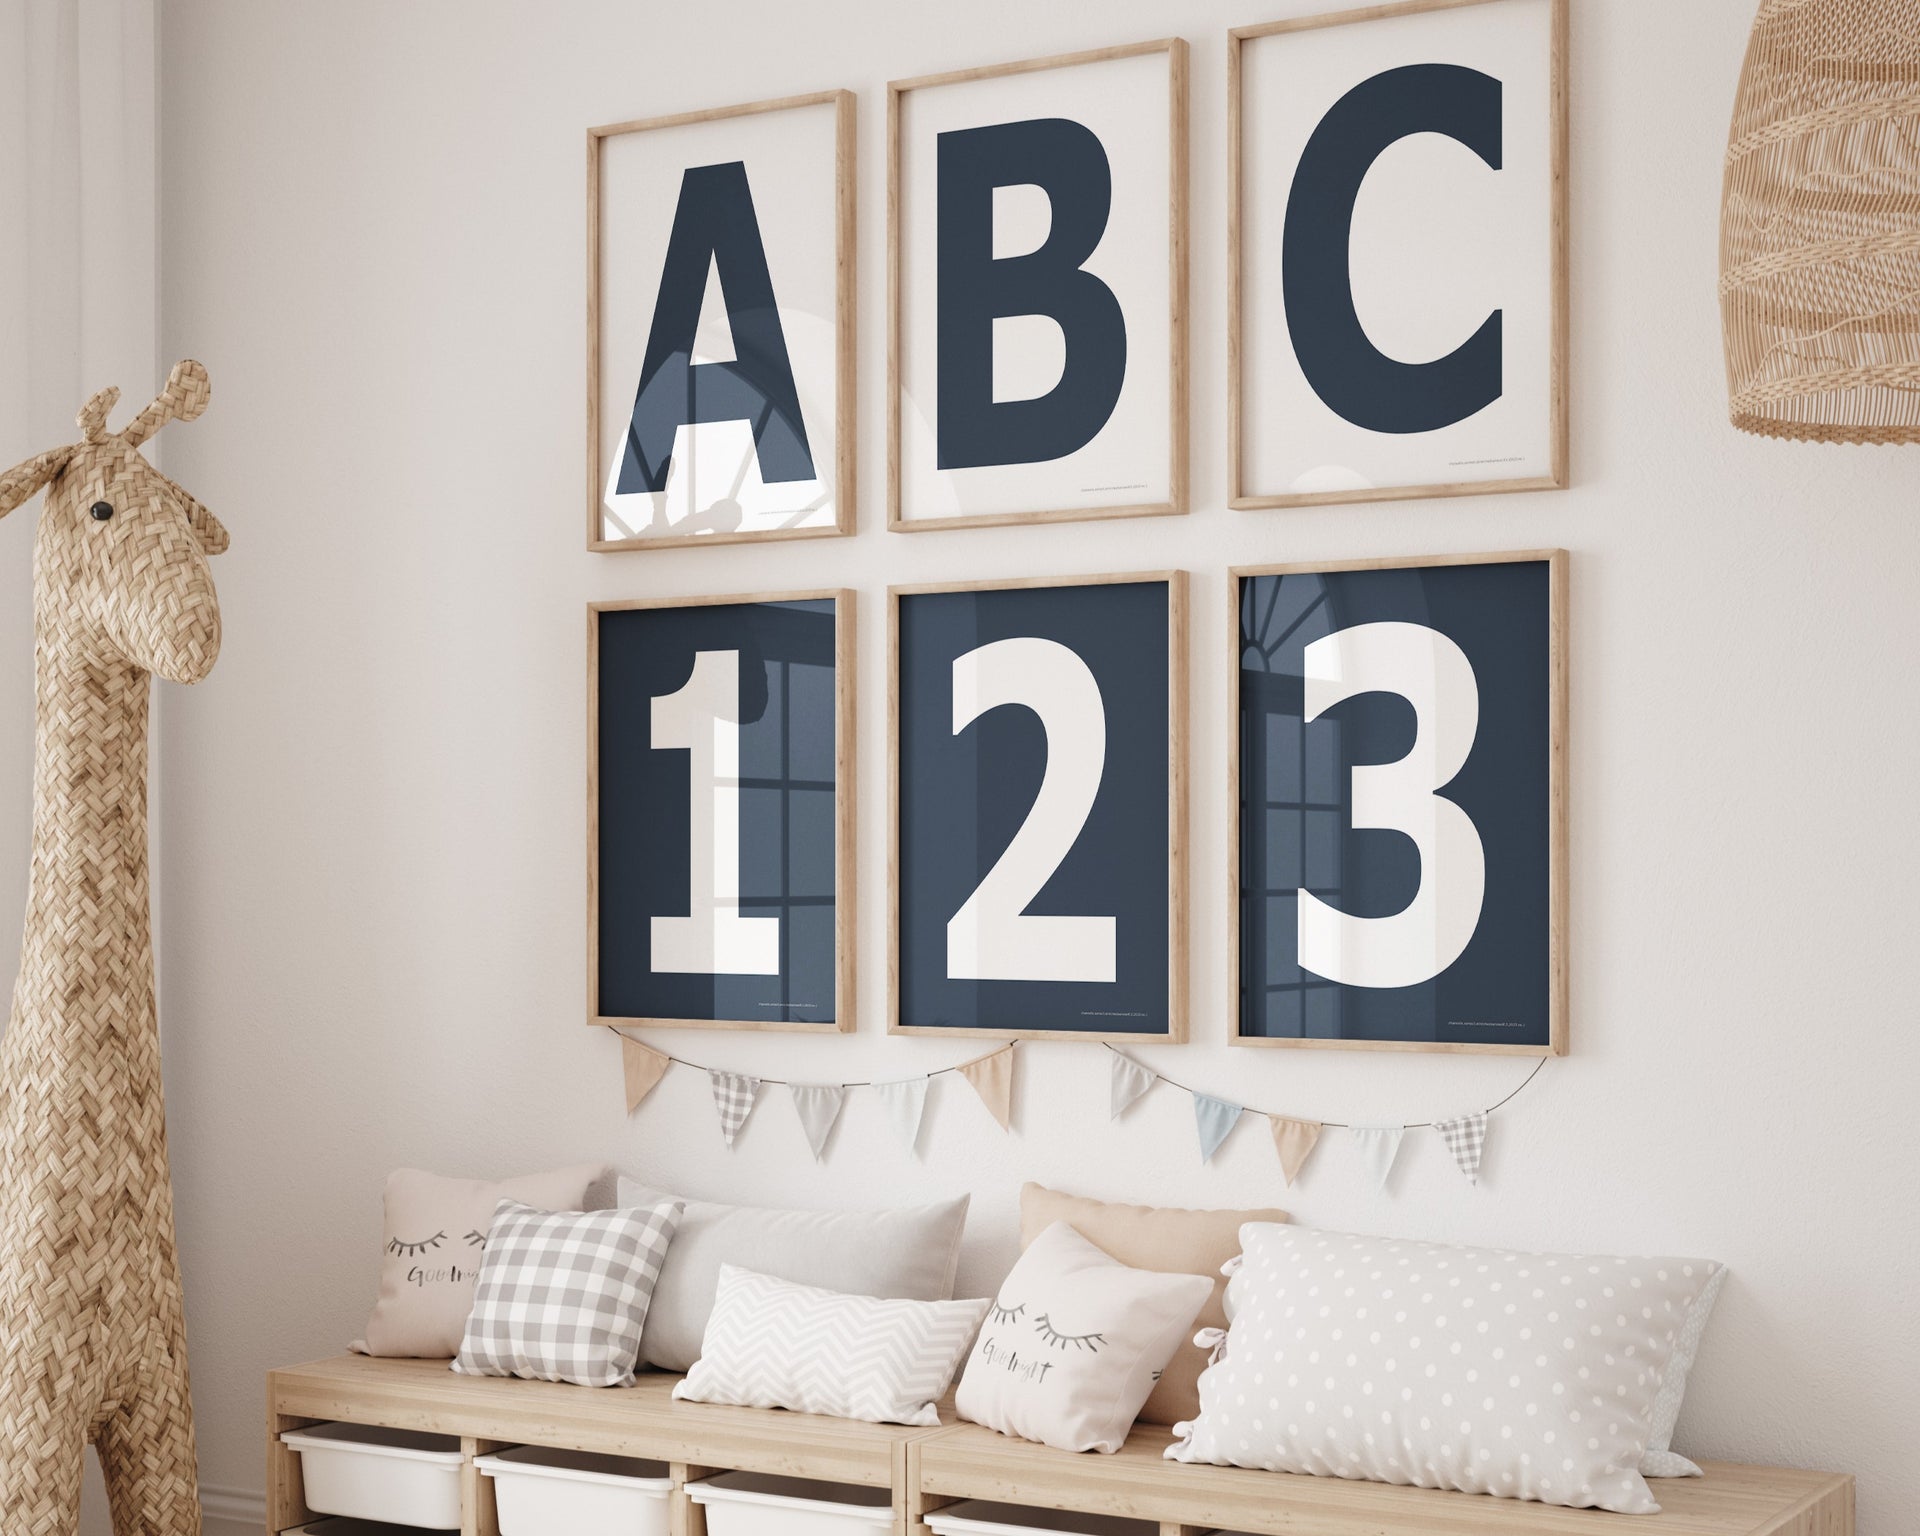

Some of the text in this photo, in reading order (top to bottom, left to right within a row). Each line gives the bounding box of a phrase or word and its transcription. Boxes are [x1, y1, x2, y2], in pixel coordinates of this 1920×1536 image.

[616, 161, 816, 495] A
[937, 118, 1126, 470] B
[1282, 64, 1502, 434] C
[651, 650, 779, 975] 1
[947, 638, 1116, 982] 2
[1298, 622, 1485, 988] 3
